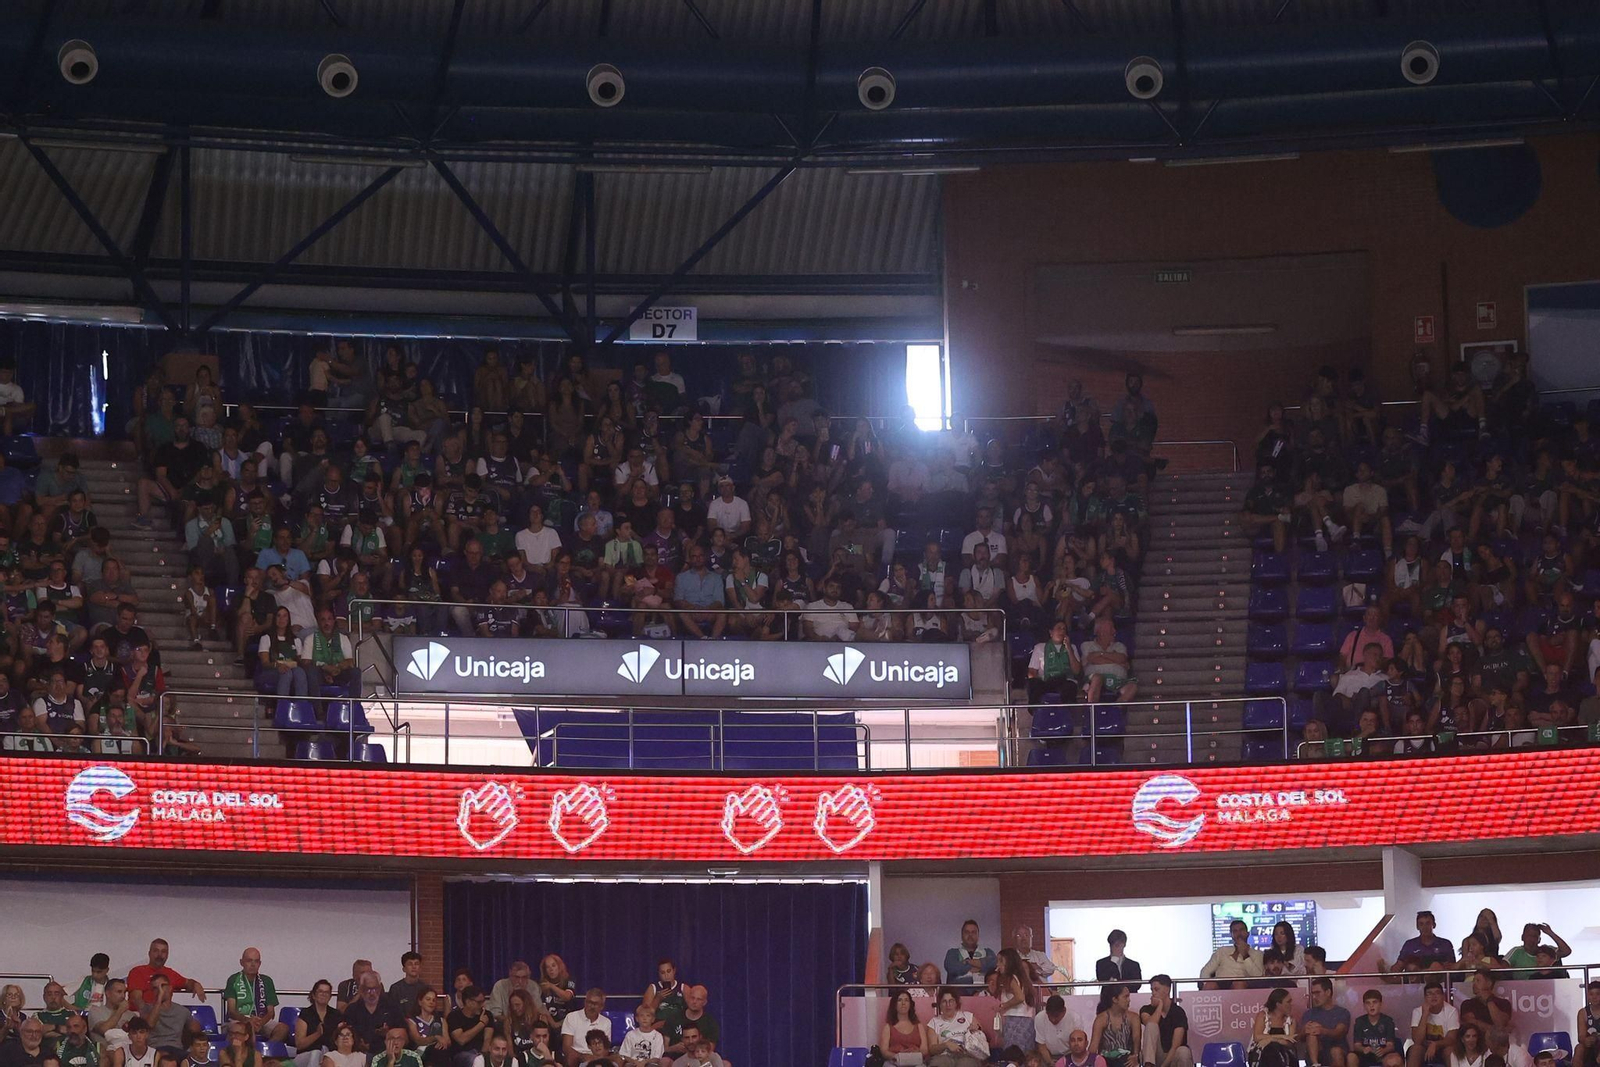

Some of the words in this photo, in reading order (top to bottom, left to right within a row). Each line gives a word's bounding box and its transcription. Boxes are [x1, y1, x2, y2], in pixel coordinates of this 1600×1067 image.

[652, 323, 678, 339] D7
[454, 655, 546, 684] Unicaja
[664, 657, 755, 687] Unicaja
[869, 660, 959, 689] Unicaja
[151, 790, 209, 805] COSTA
[212, 792, 246, 807] DEL
[249, 793, 283, 808] SOL
[1216, 792, 1275, 808] COSTA
[1277, 790, 1310, 806] DEL
[1314, 789, 1348, 804] SOL
[1231, 1019, 1246, 1029] de
